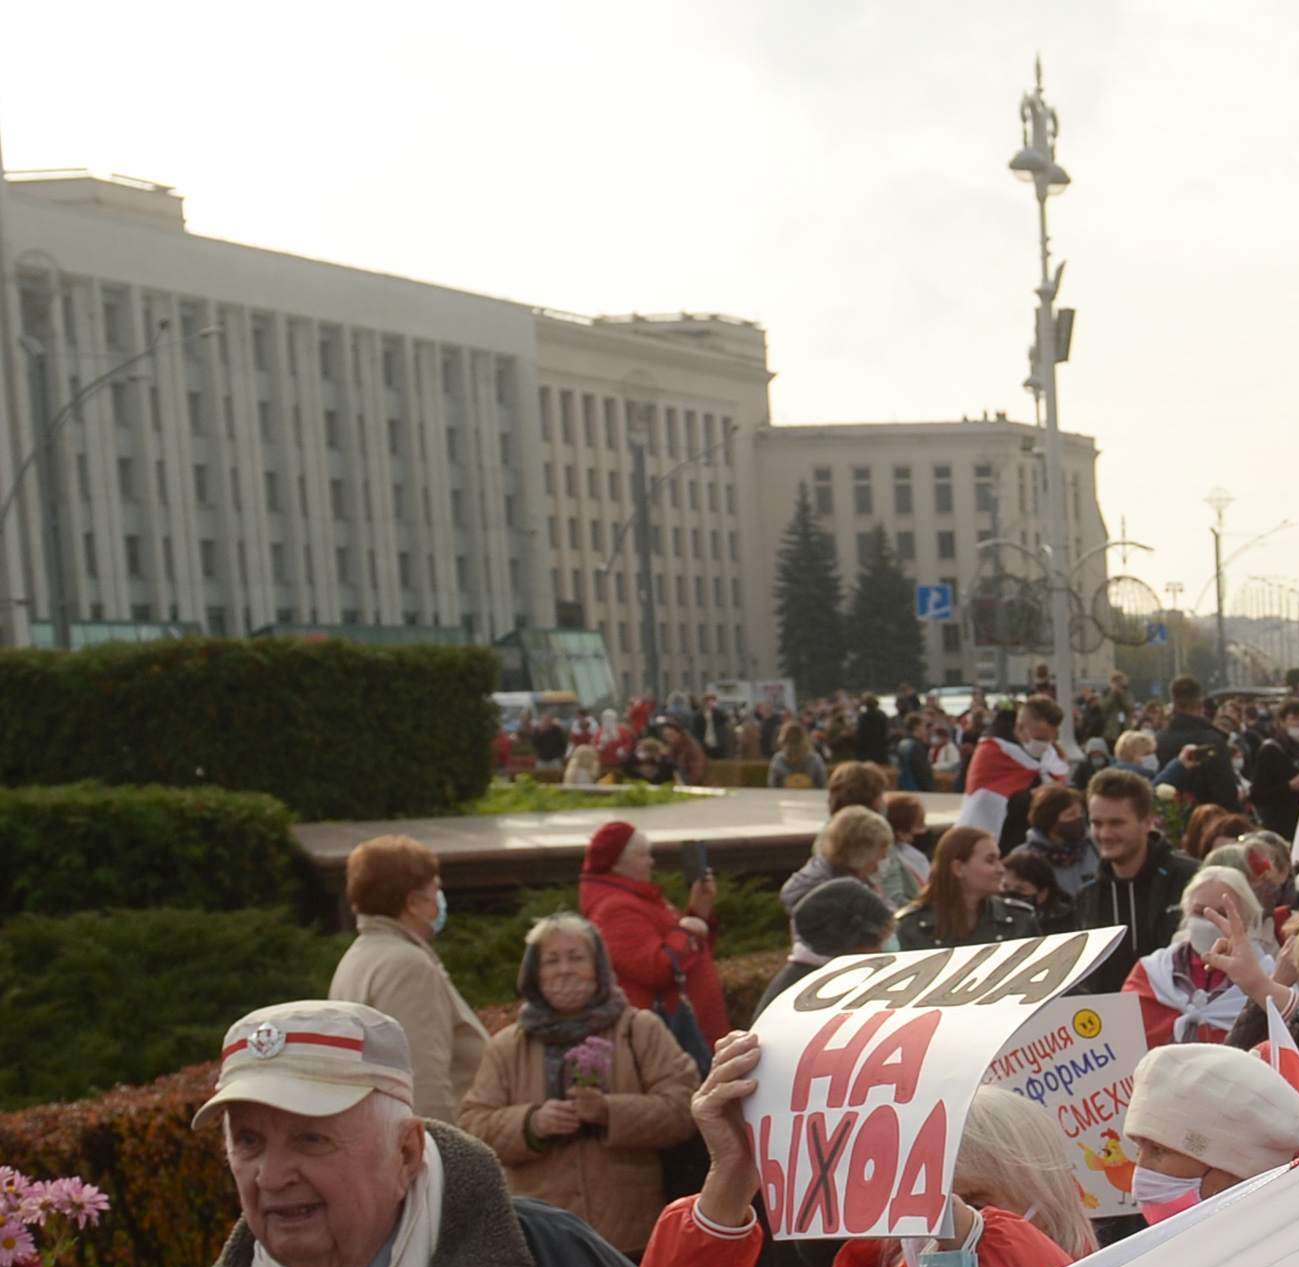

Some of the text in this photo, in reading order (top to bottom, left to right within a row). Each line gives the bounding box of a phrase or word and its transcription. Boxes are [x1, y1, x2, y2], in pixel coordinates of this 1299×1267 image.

[793, 931, 1090, 1013] САША
[790, 1009, 943, 1112] НА
[745, 1099, 947, 1235] ЫХОД
